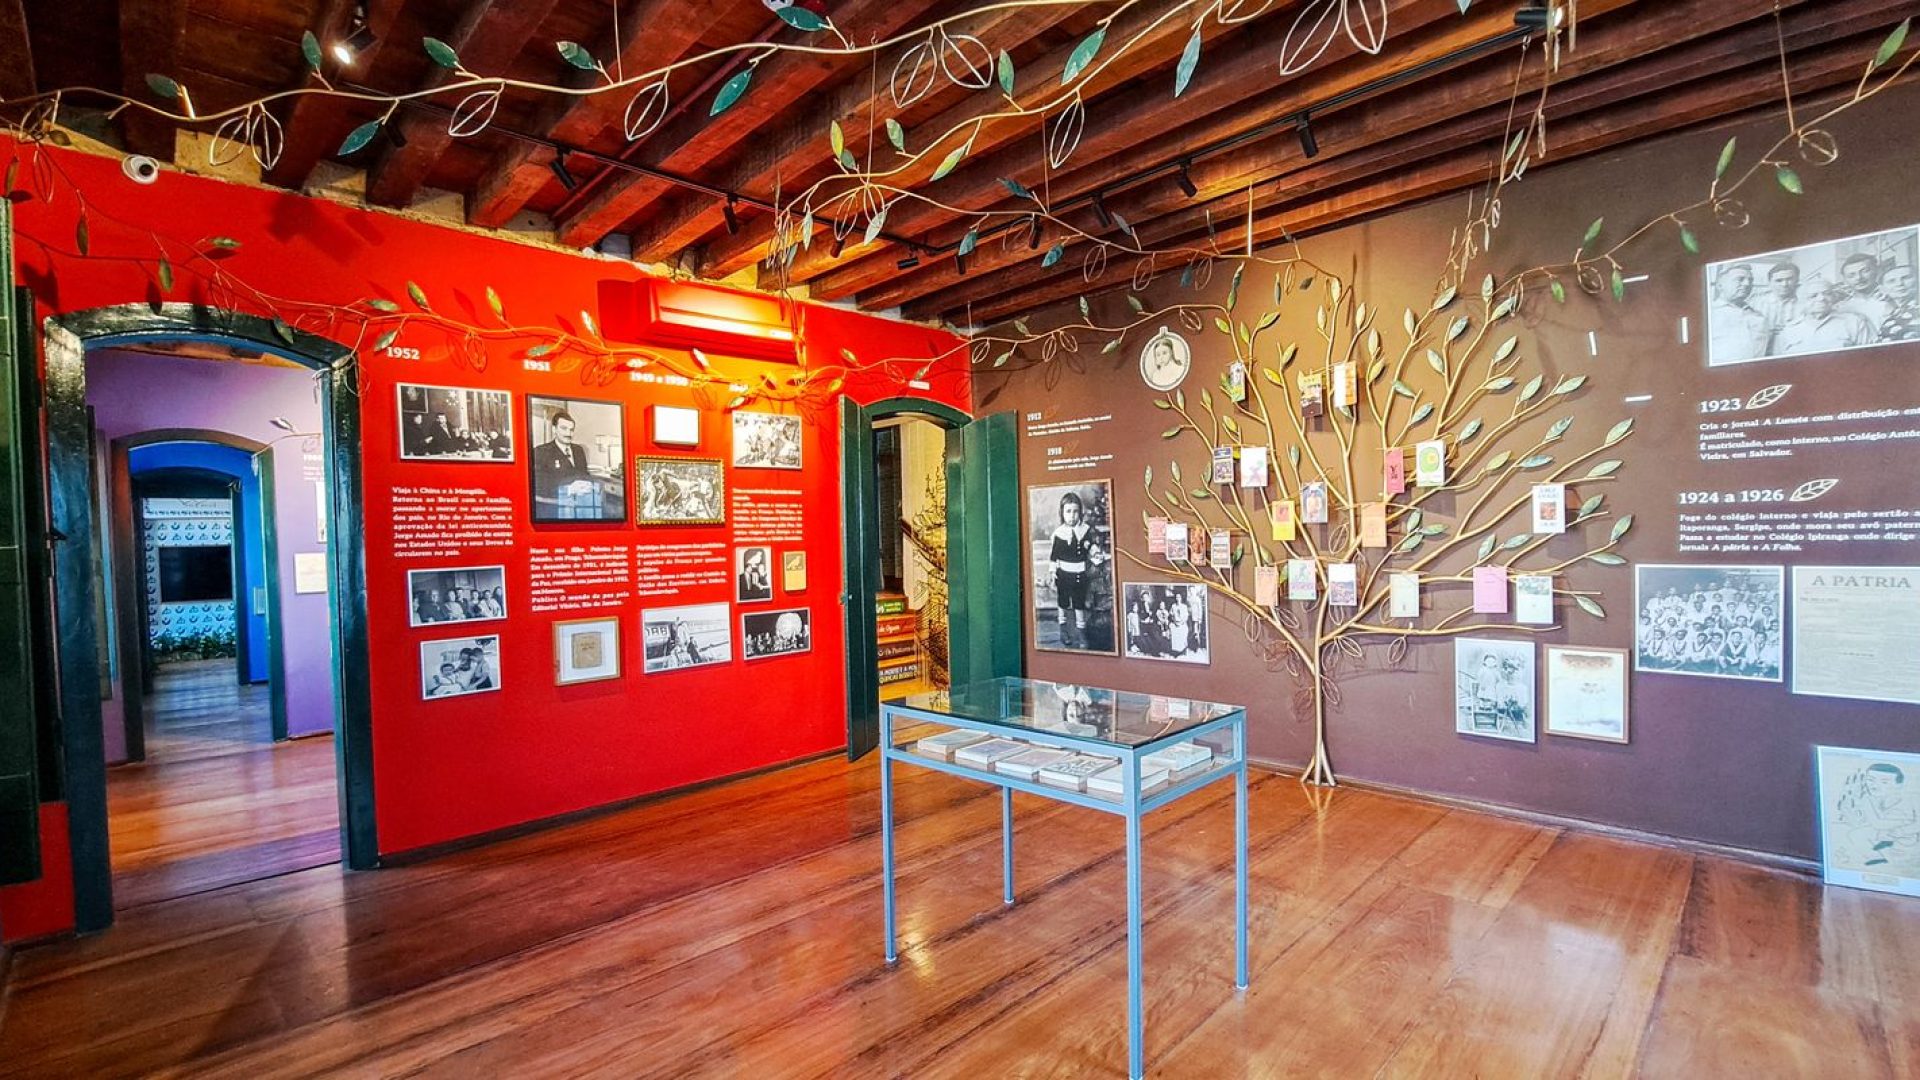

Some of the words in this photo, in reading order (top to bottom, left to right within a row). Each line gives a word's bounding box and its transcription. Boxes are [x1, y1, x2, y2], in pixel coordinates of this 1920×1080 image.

[387, 347, 420, 360] 1952
[523, 359, 550, 371] 1951
[1700, 398, 1741, 412] 1923
[1732, 419, 1758, 429] jornal
[1838, 409, 1899, 421] distribuição
[1700, 432, 1746, 440] familiares.
[1708, 440, 1763, 449] matriculado,
[1793, 437, 1831, 445] interno,
[1848, 432, 1886, 441] Colégio
[1750, 449, 1792, 457] Salvador.
[1679, 491, 1719, 504] 1924
[1724, 493, 1735, 503] a
[1741, 489, 1784, 502] 1926
[1721, 513, 1755, 522] colégio
[1760, 511, 1797, 519] interno
[1813, 511, 1839, 520] viaja
[1844, 511, 1867, 519] pelo
[1873, 509, 1908, 517] sertão
[1680, 523, 1730, 532] Itaporanga,
[1735, 523, 1772, 532] Sergipe,
[1776, 522, 1801, 530] onde
[1860, 521, 1879, 529] avô
[1769, 532, 1804, 541] Colégio
[1808, 533, 1850, 541] Ipiranga
[1854, 532, 1880, 540] onde
[1883, 532, 1915, 540] dirige
[1812, 575, 1825, 586] A
[1833, 576, 1911, 588] PATRIA
